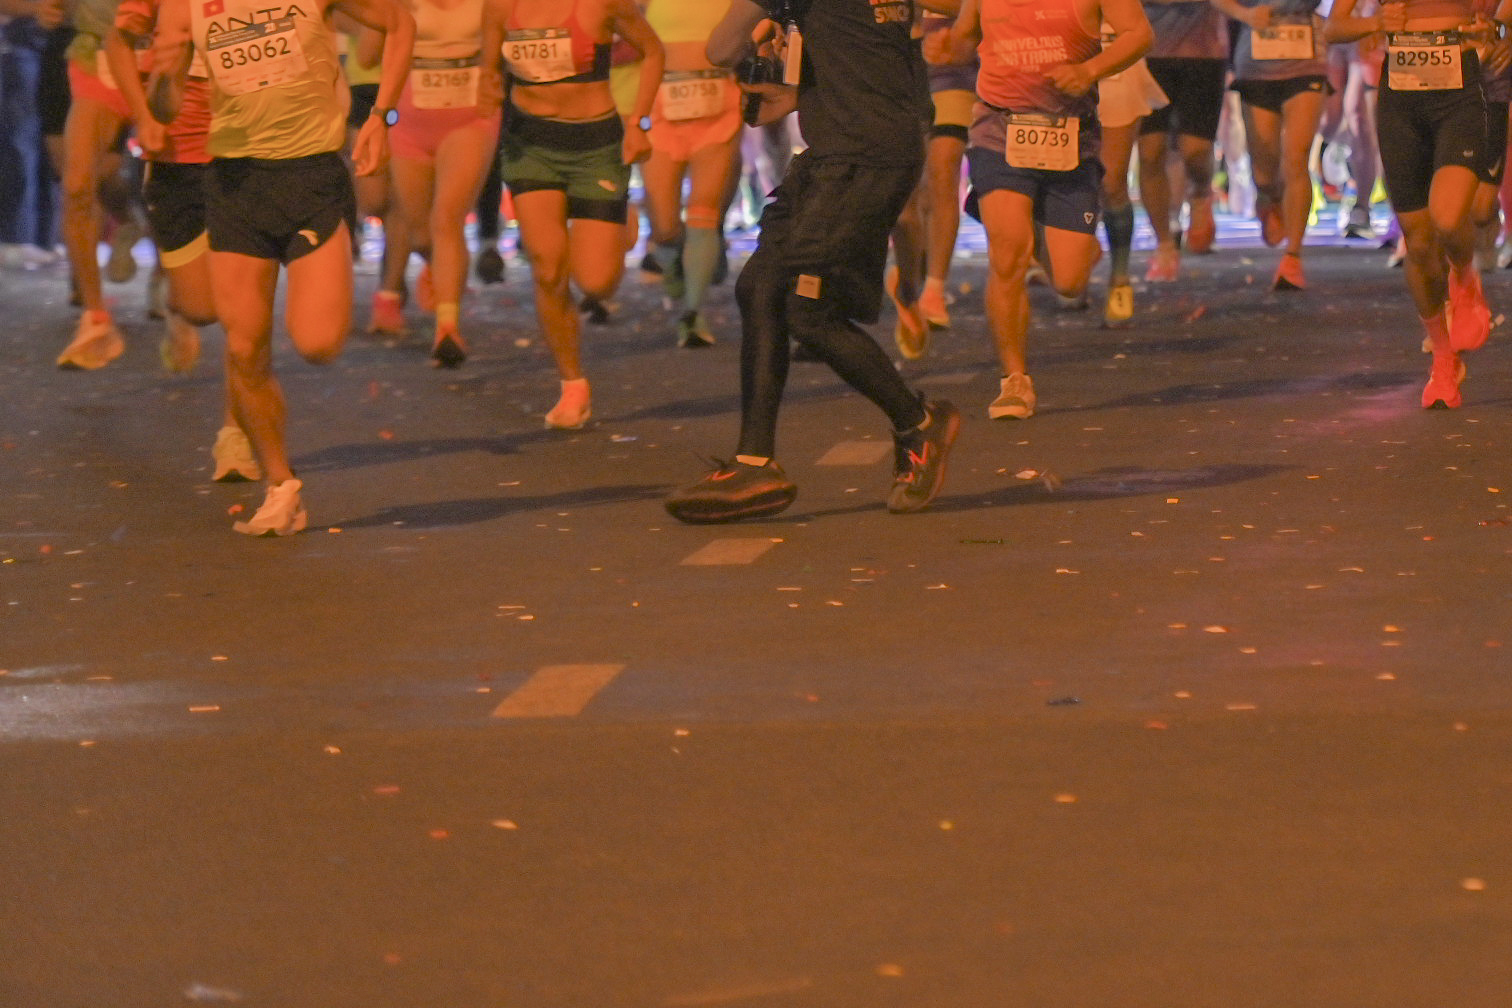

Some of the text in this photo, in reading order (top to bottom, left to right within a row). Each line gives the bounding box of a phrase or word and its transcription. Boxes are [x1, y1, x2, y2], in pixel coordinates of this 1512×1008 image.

[220, 37, 292, 70] 83062
[511, 43, 558, 61] 81781
[1396, 49, 1453, 67] 82955
[1015, 128, 1070, 148] 80739
